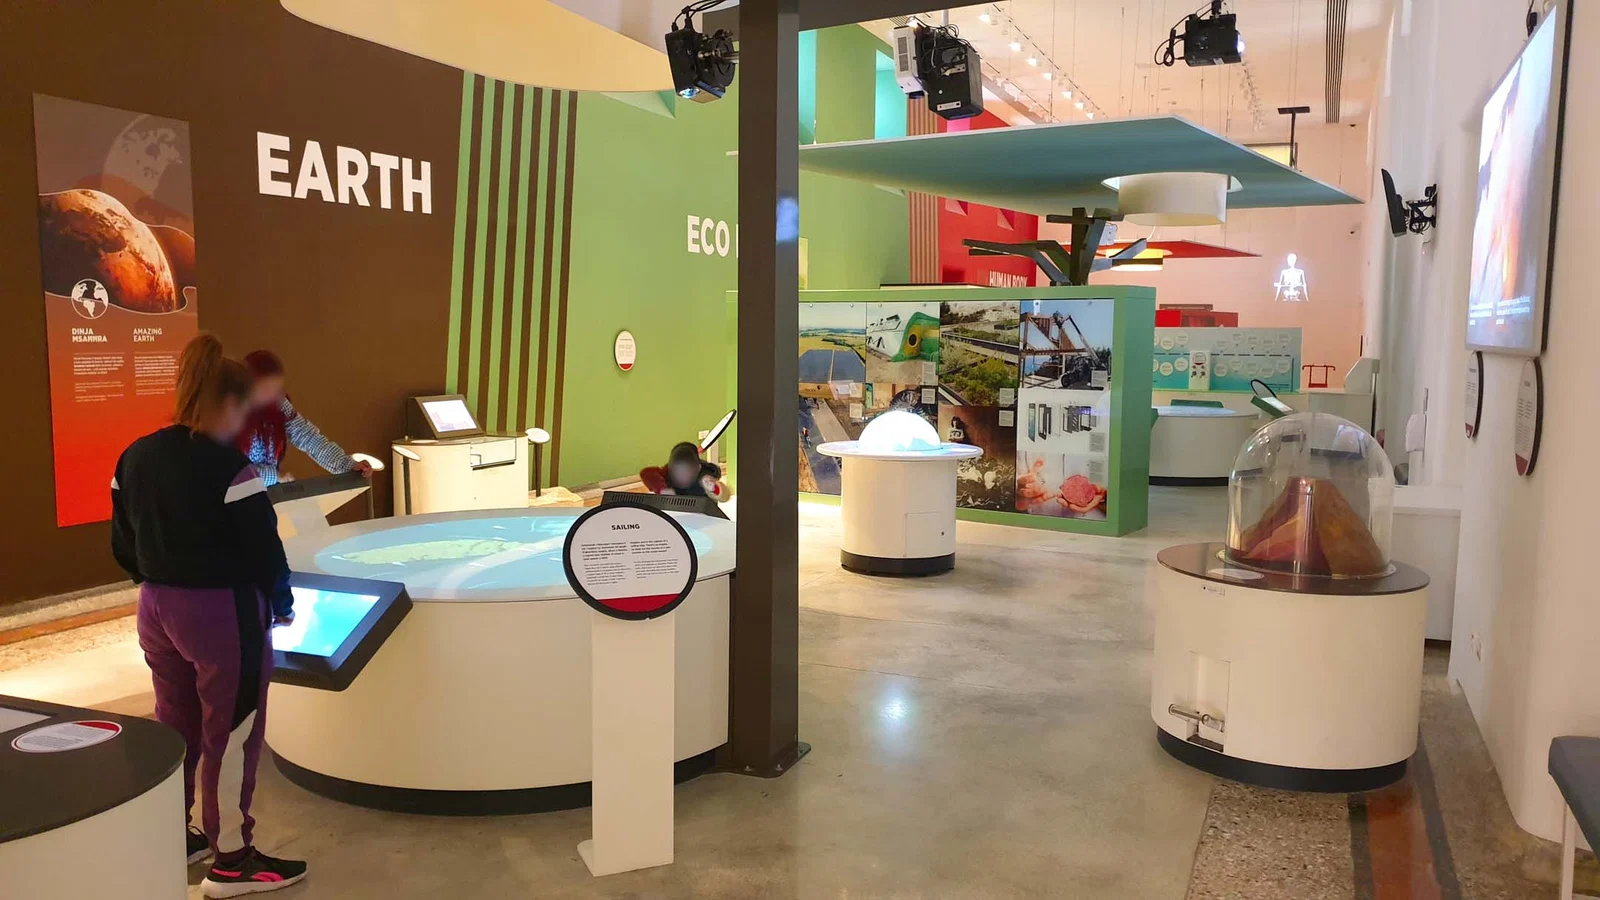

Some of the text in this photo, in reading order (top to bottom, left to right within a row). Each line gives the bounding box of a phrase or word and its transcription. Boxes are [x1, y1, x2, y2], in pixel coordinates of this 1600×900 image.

[256, 132, 432, 214] EARTH
[687, 214, 730, 258] ECO
[989, 271, 1011, 288] HUMAN
[611, 523, 640, 531] SAILING
